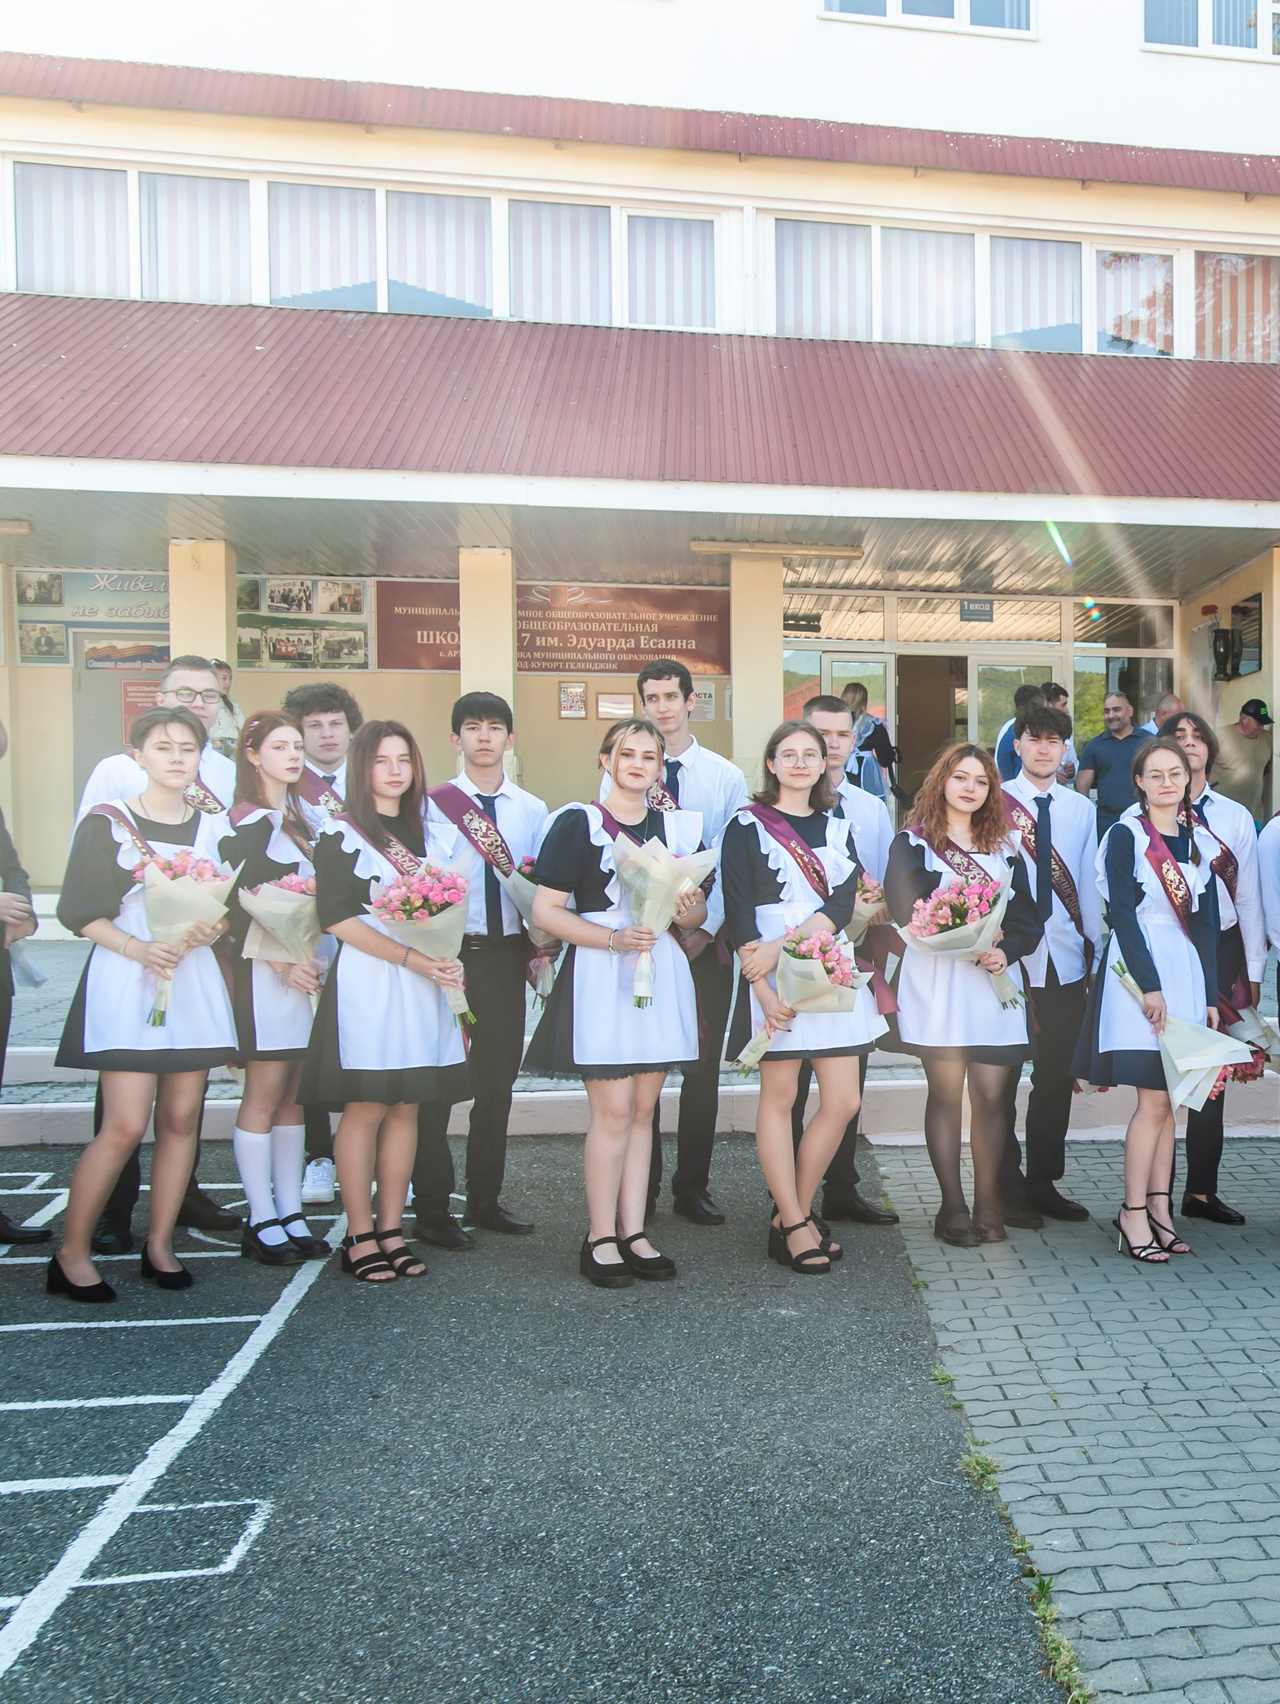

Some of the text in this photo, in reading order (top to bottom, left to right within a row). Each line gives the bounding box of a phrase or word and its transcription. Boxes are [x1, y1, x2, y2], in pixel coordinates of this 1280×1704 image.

[71, 604, 99, 617] не
[394, 606, 718, 622] МУНИЦИПАЛЬ МНОЕ ОБЩЕОБРАЗОВАТЕЛЬНОЕ УЧРЕЖДЕНИЕ
[517, 620, 659, 633] БЩЕОБРАЗОВАТЕЛЬНАЯ
[416, 630, 460, 645] ШКО
[536, 636, 563, 647] им.
[567, 634, 636, 652] Эдуарда
[640, 636, 696, 650] Есаяна
[533, 652, 616, 661] МУНИЦИПАЛЬНОГО
[517, 661, 618, 670] ОД-КУРОРТ ГЕЛЕНДЖИК
